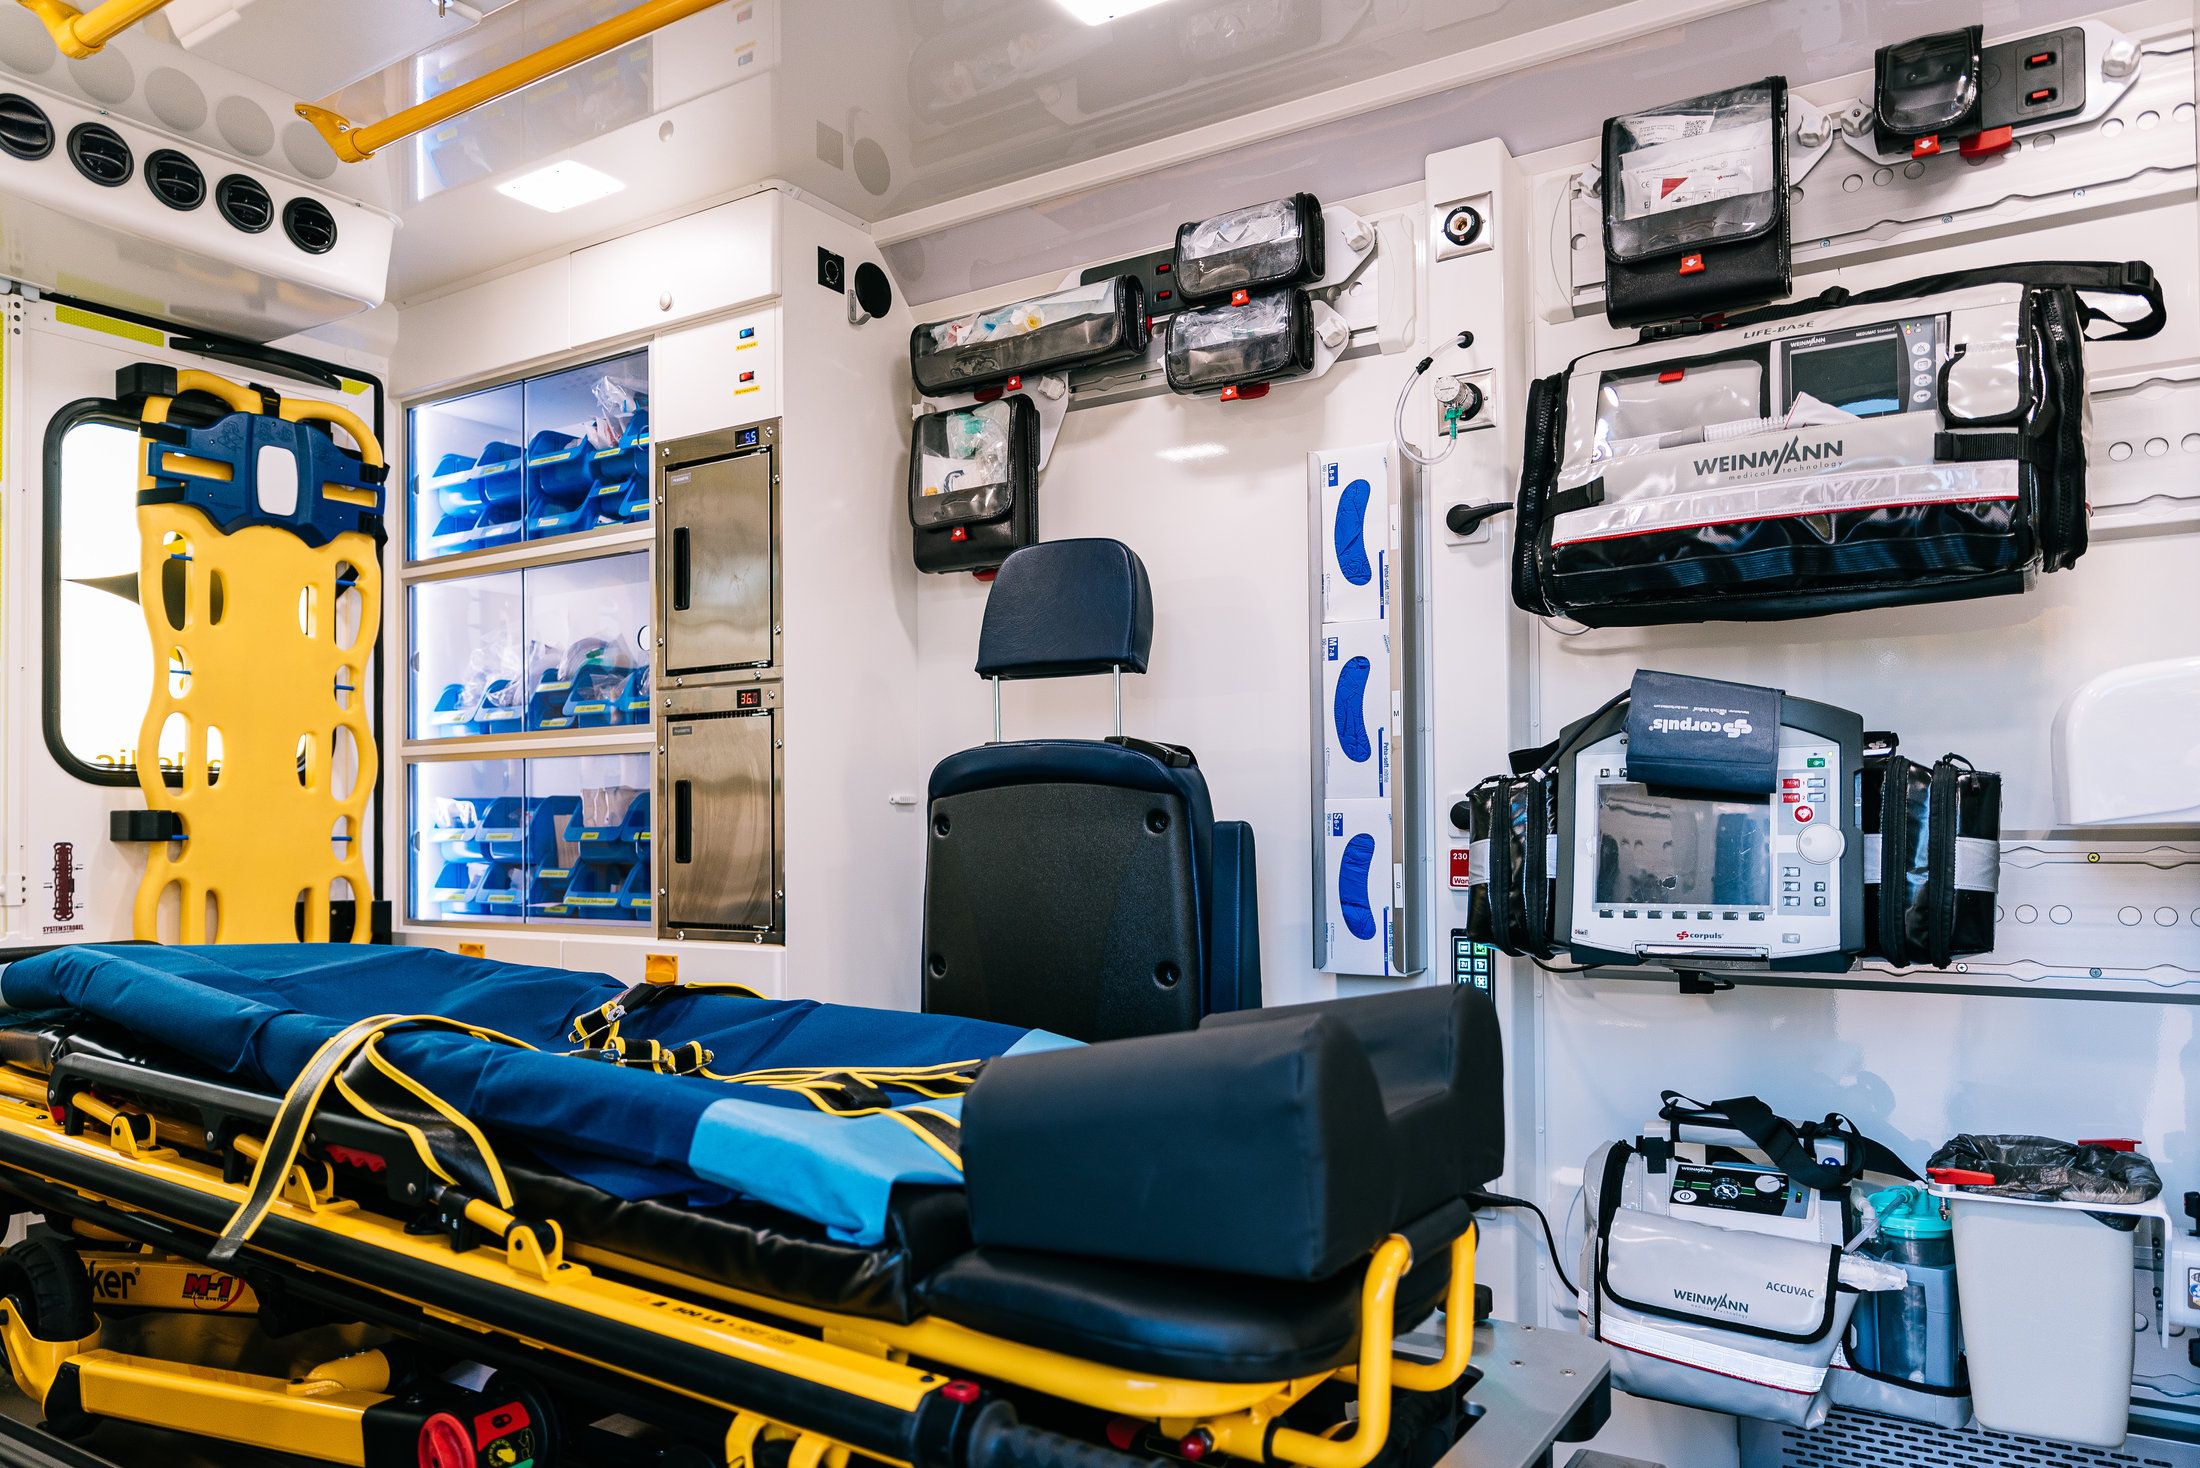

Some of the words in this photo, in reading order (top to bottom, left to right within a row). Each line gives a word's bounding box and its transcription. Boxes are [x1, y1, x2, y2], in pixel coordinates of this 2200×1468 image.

[1743, 320, 1815, 340] LIFE-BASE
[1790, 336, 1827, 348] WEINMANN
[1693, 434, 1844, 476] WEINMANN
[1728, 468, 1770, 481] medical
[1782, 460, 1844, 474] technology
[1328, 637, 1338, 646] M
[1452, 852, 1468, 861] 230
[1395, 881, 1402, 889] S
[43, 925, 62, 933] SYSTEM
[1765, 1281, 1815, 1299] ACCUVAC
[1673, 1288, 1749, 1314] WEINMANN
[1690, 1303, 1712, 1312] medical
[1717, 1309, 1749, 1320] technology
